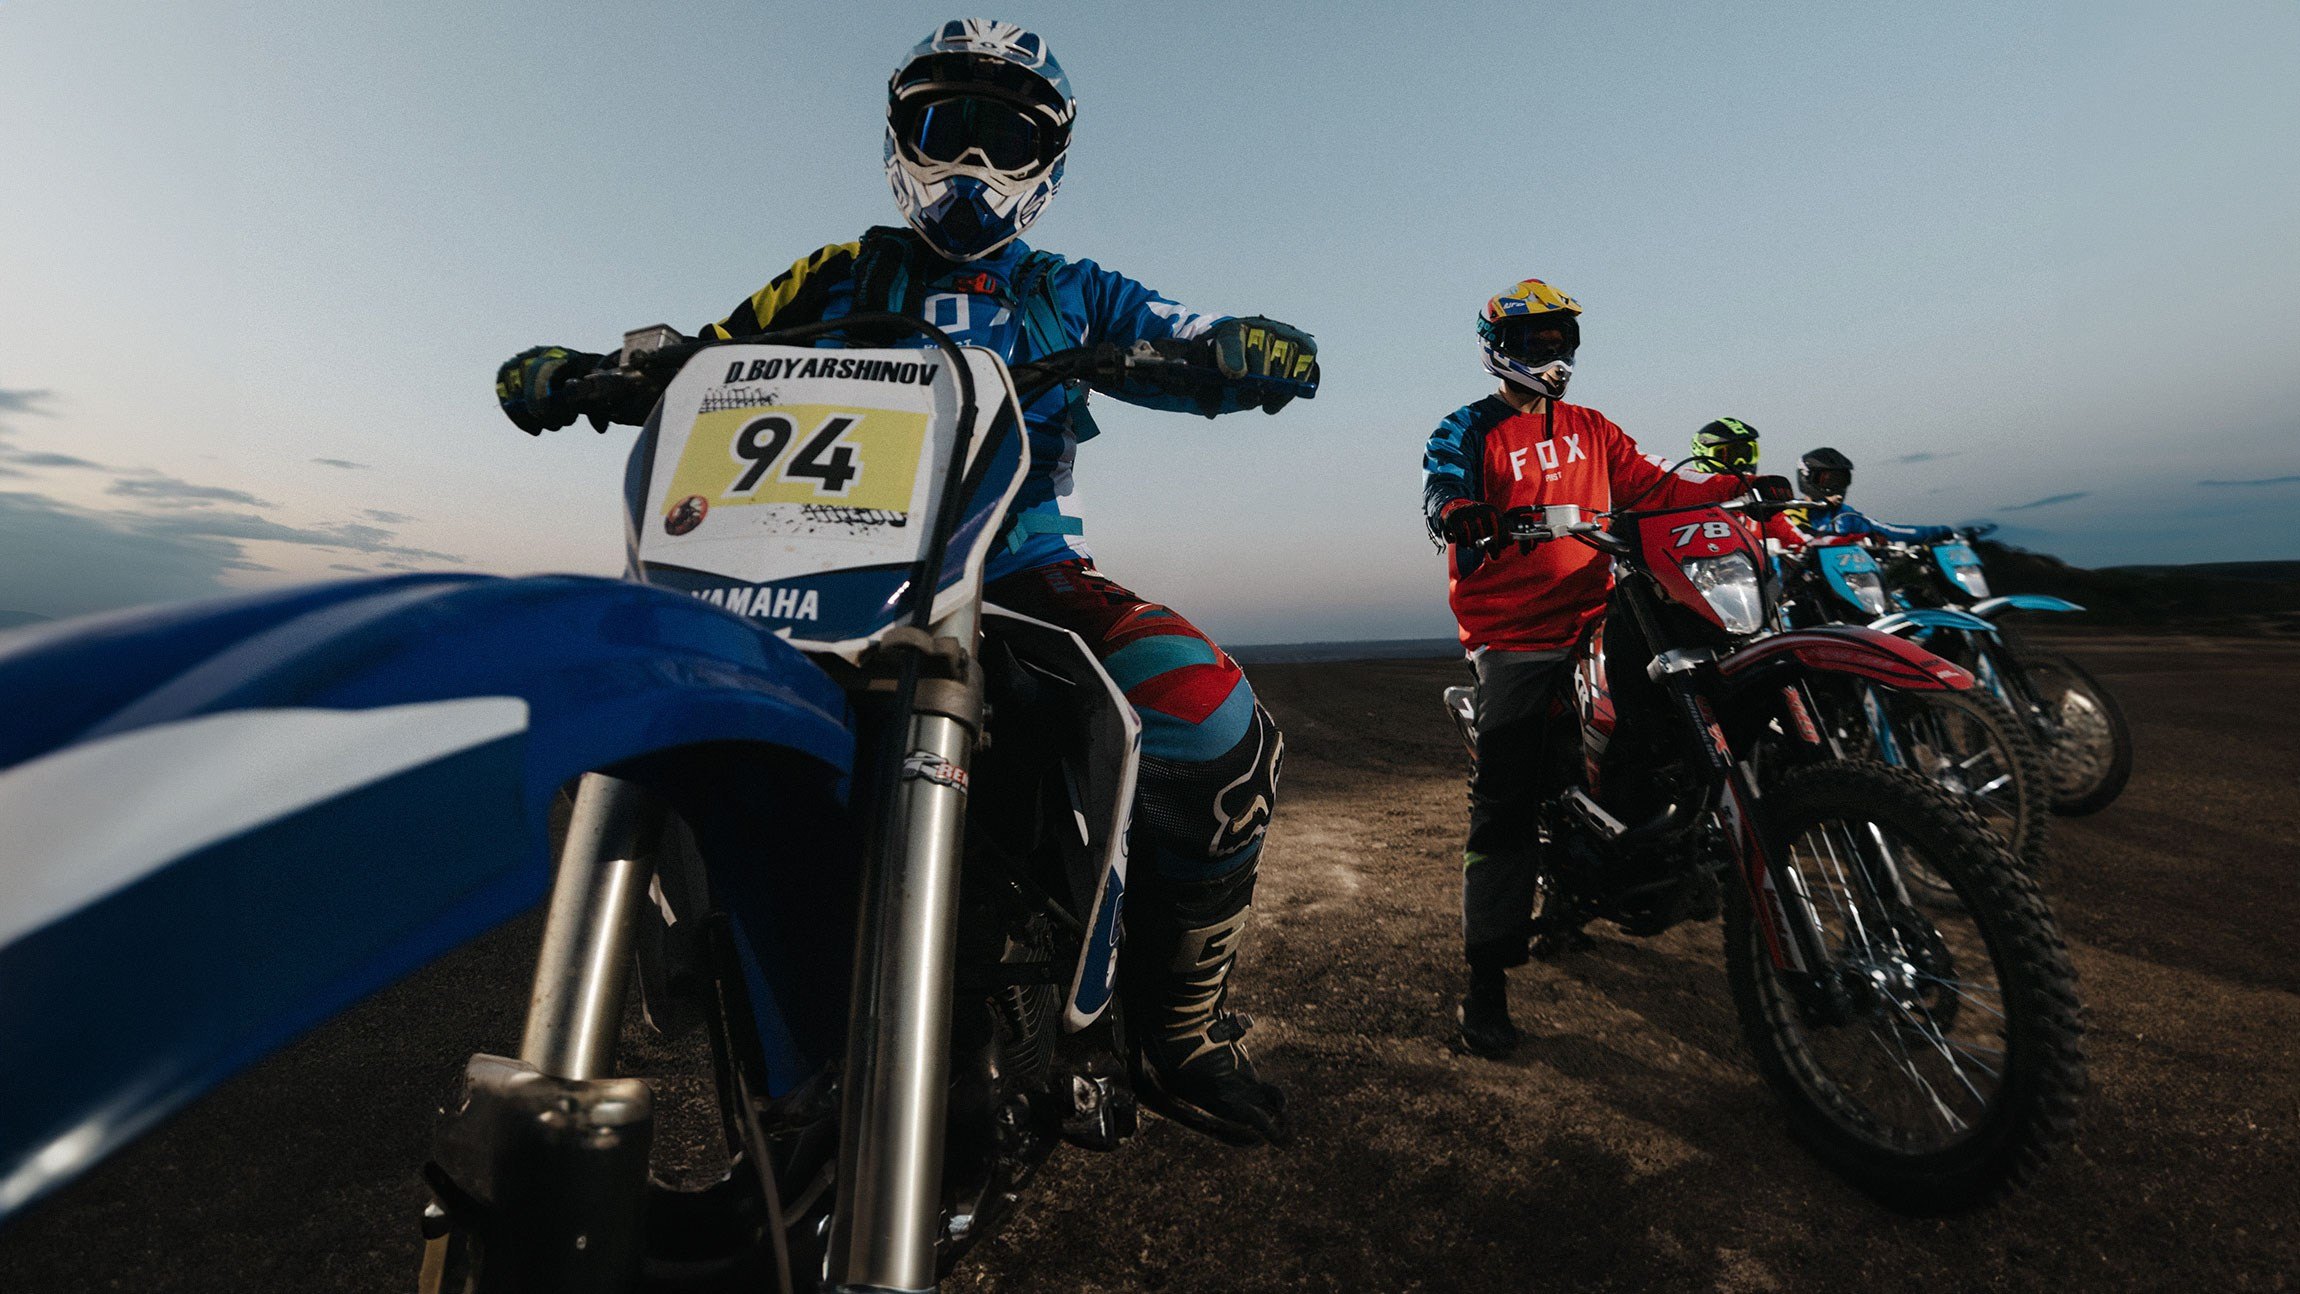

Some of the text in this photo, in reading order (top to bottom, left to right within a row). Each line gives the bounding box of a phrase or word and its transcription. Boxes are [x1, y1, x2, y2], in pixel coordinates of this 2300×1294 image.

[724, 358, 938, 386] D.BOYARSHINOV
[729, 413, 858, 494] 94
[1509, 433, 1586, 482] FOX
[1669, 521, 1732, 549] 78
